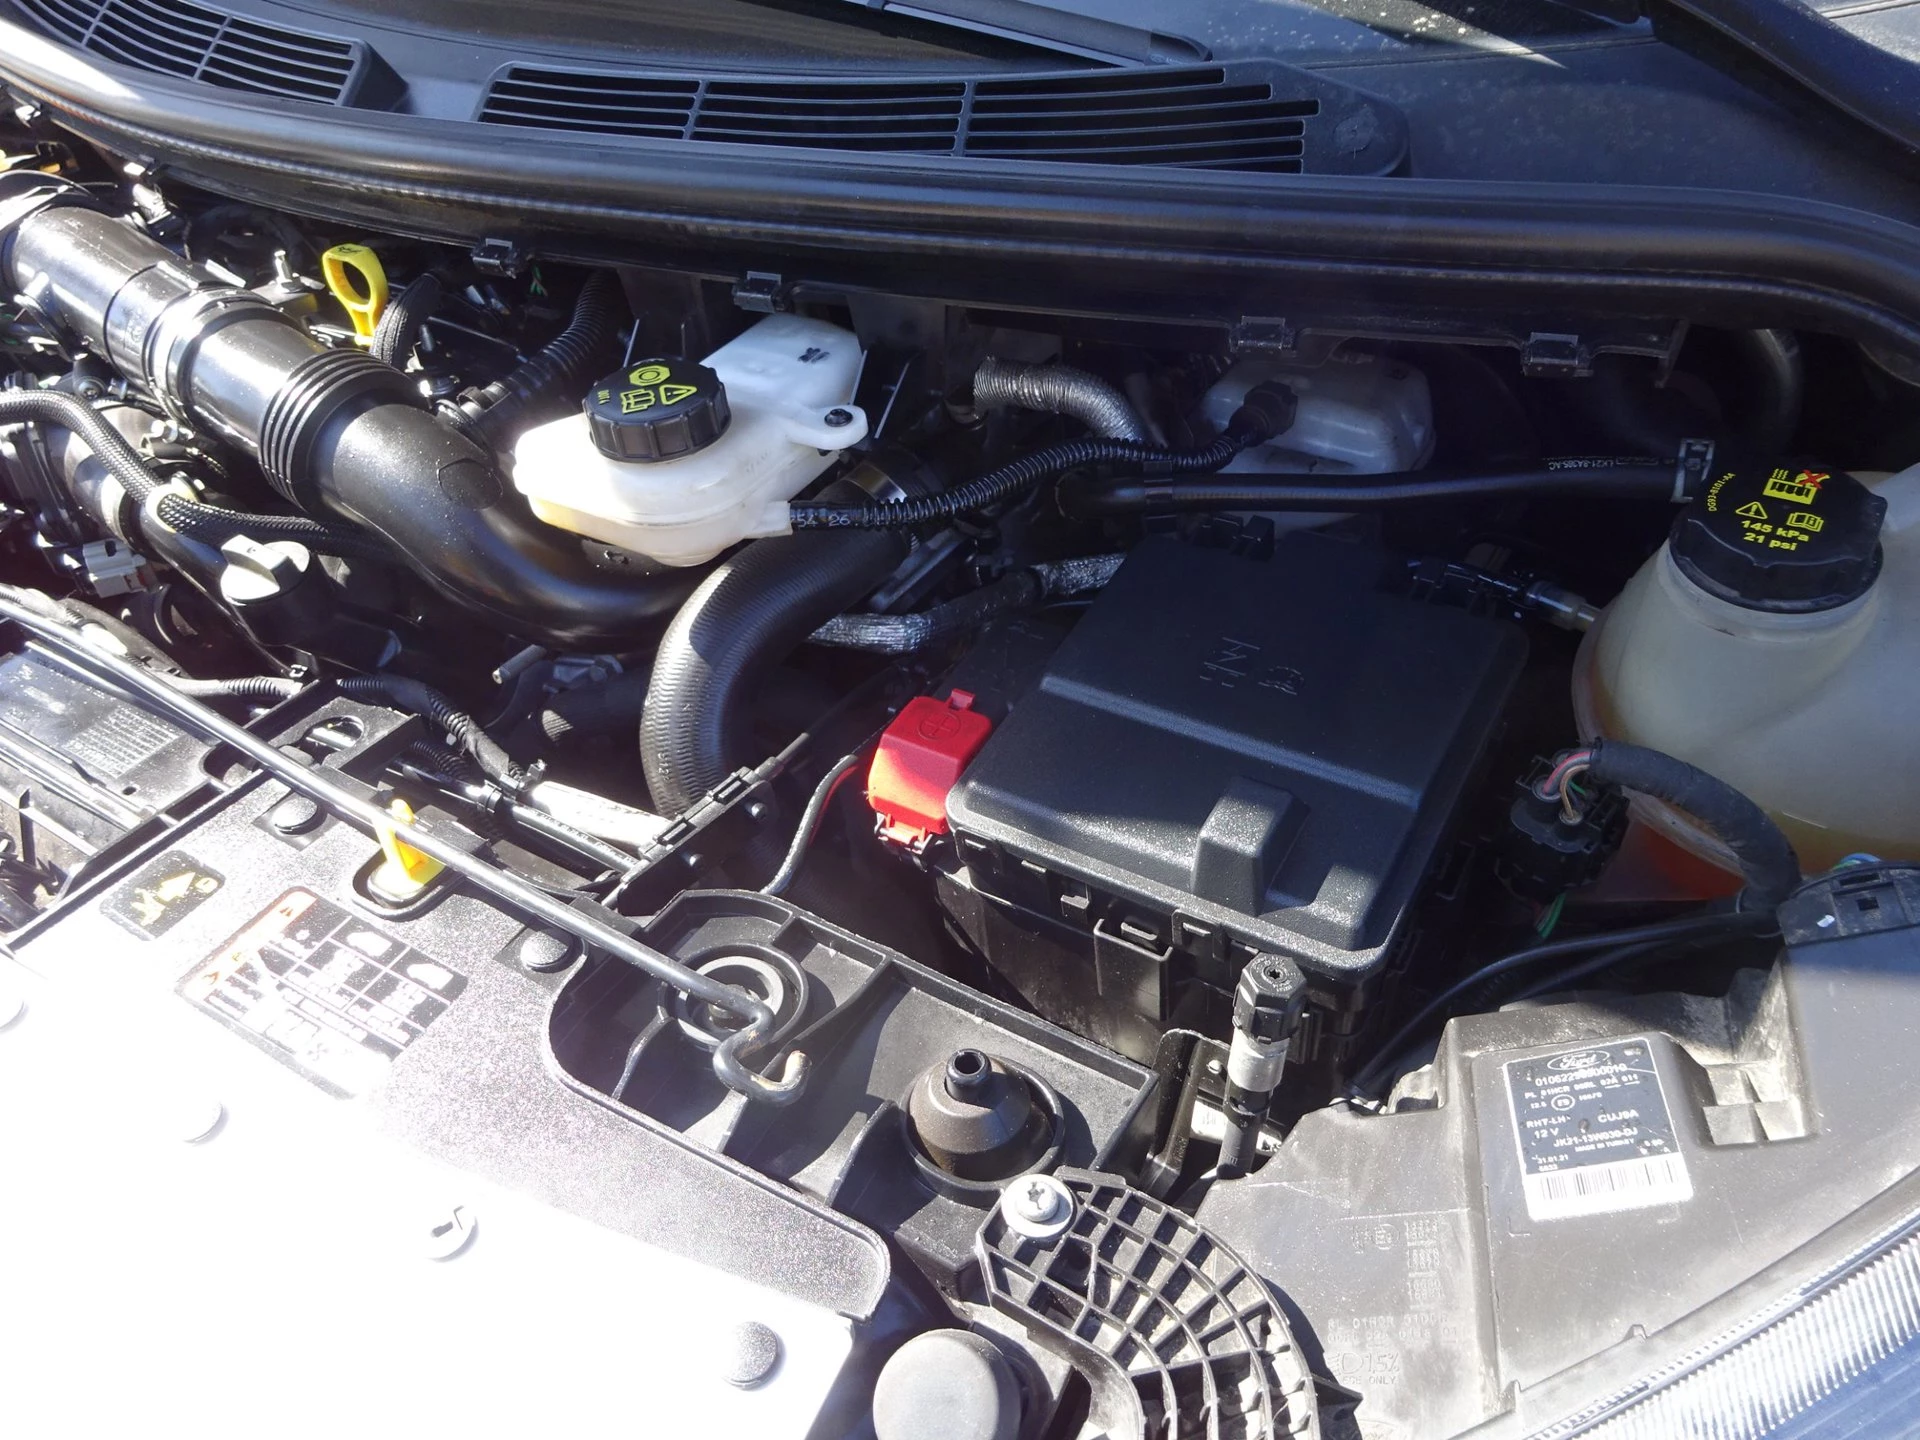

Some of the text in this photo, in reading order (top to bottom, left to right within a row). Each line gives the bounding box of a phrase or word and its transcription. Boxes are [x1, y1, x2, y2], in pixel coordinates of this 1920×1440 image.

[1741, 519, 1810, 542] 145 kPa
[1743, 532, 1798, 552] 21 psi
[1534, 1127, 1559, 1139] 12 V
[1368, 1375, 1397, 1386] ONLY
